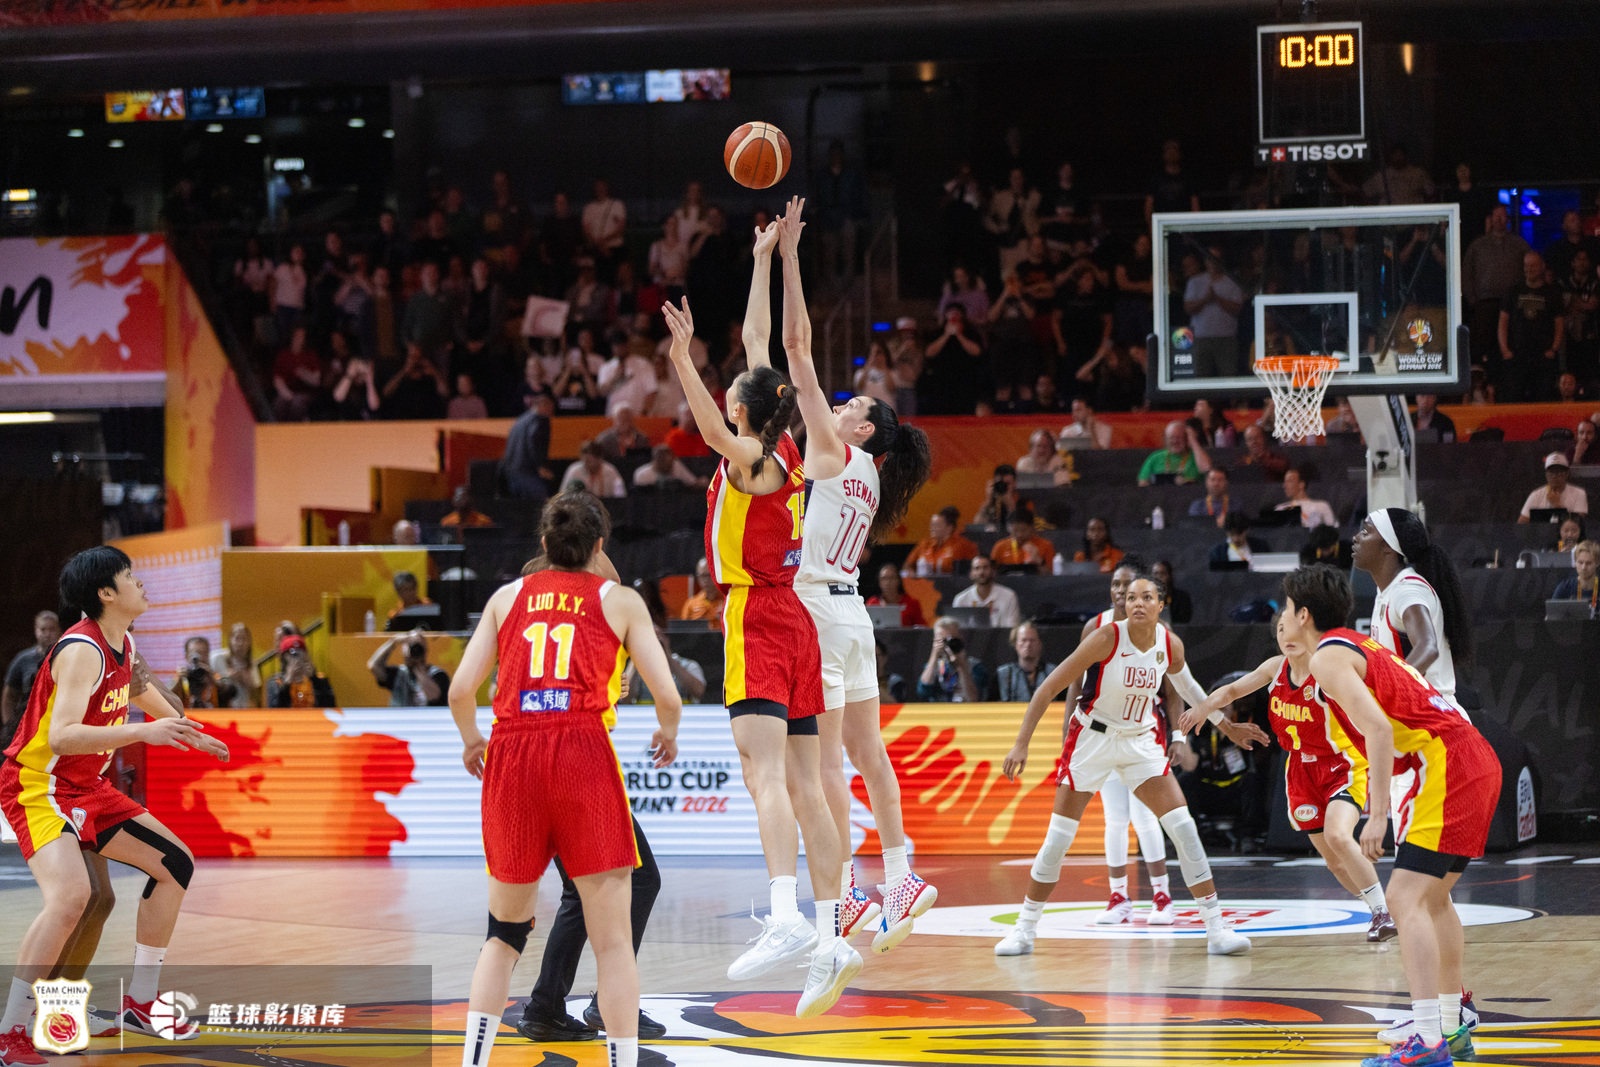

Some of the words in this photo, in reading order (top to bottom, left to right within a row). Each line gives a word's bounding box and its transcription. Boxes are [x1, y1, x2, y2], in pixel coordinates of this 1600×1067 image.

[1280, 34, 1354, 68] 10:00
[1288, 143, 1367, 161] TISSOT
[1398, 356, 1425, 364] WORLD
[826, 503, 871, 574] 10
[527, 592, 555, 613] LUO
[557, 592, 586, 616] X.Y.
[522, 622, 575, 680] 11
[1124, 666, 1156, 689] USA
[543, 690, 570, 710] 秀域
[1122, 694, 1149, 723] 11
[1270, 696, 1314, 722] CHINA
[1285, 725, 1301, 750] 1
[624, 772, 673, 790] RLD
[680, 772, 730, 790] CUP
[630, 796, 677, 813] MANY
[681, 796, 730, 813] 2026
